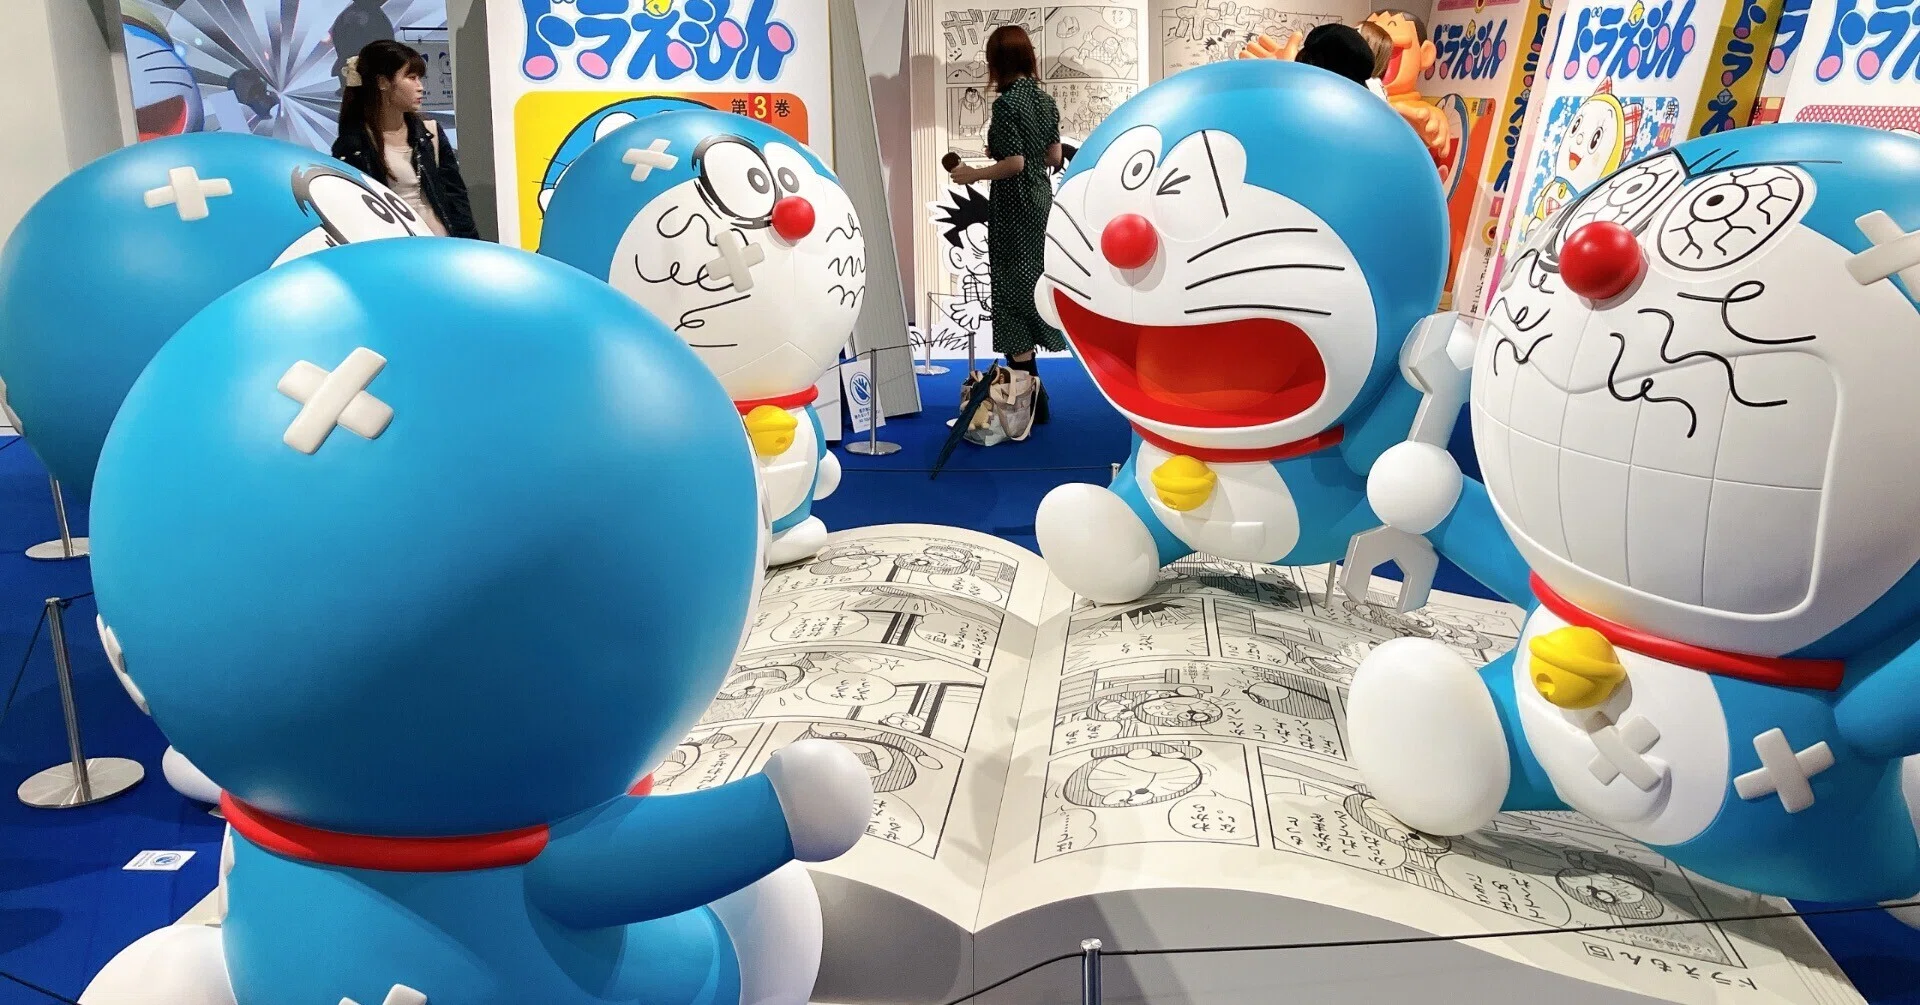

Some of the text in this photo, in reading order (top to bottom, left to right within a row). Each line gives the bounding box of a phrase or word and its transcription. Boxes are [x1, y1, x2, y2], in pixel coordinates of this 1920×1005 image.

[522, 0, 796, 80] ドラえもん
[1424, 19, 1507, 80] ドラえもん
[1564, 0, 1697, 80] ドラえもん
[732, 95, 790, 119] 第3巻
[882, 817, 901, 841] せる。
[1190, 804, 1211, 833] わから
[1216, 810, 1236, 834] ない。
[1286, 815, 1304, 847] もっと
[1310, 812, 1332, 853] なかまを
[1333, 809, 1361, 858] つれてくる
[1360, 829, 1387, 867] からね。
[1466, 871, 1492, 905] さきに
[1491, 880, 1519, 914] はじめ
[1509, 872, 1546, 920] ててくれ。
[1619, 951, 1758, 991] ドラえもん
